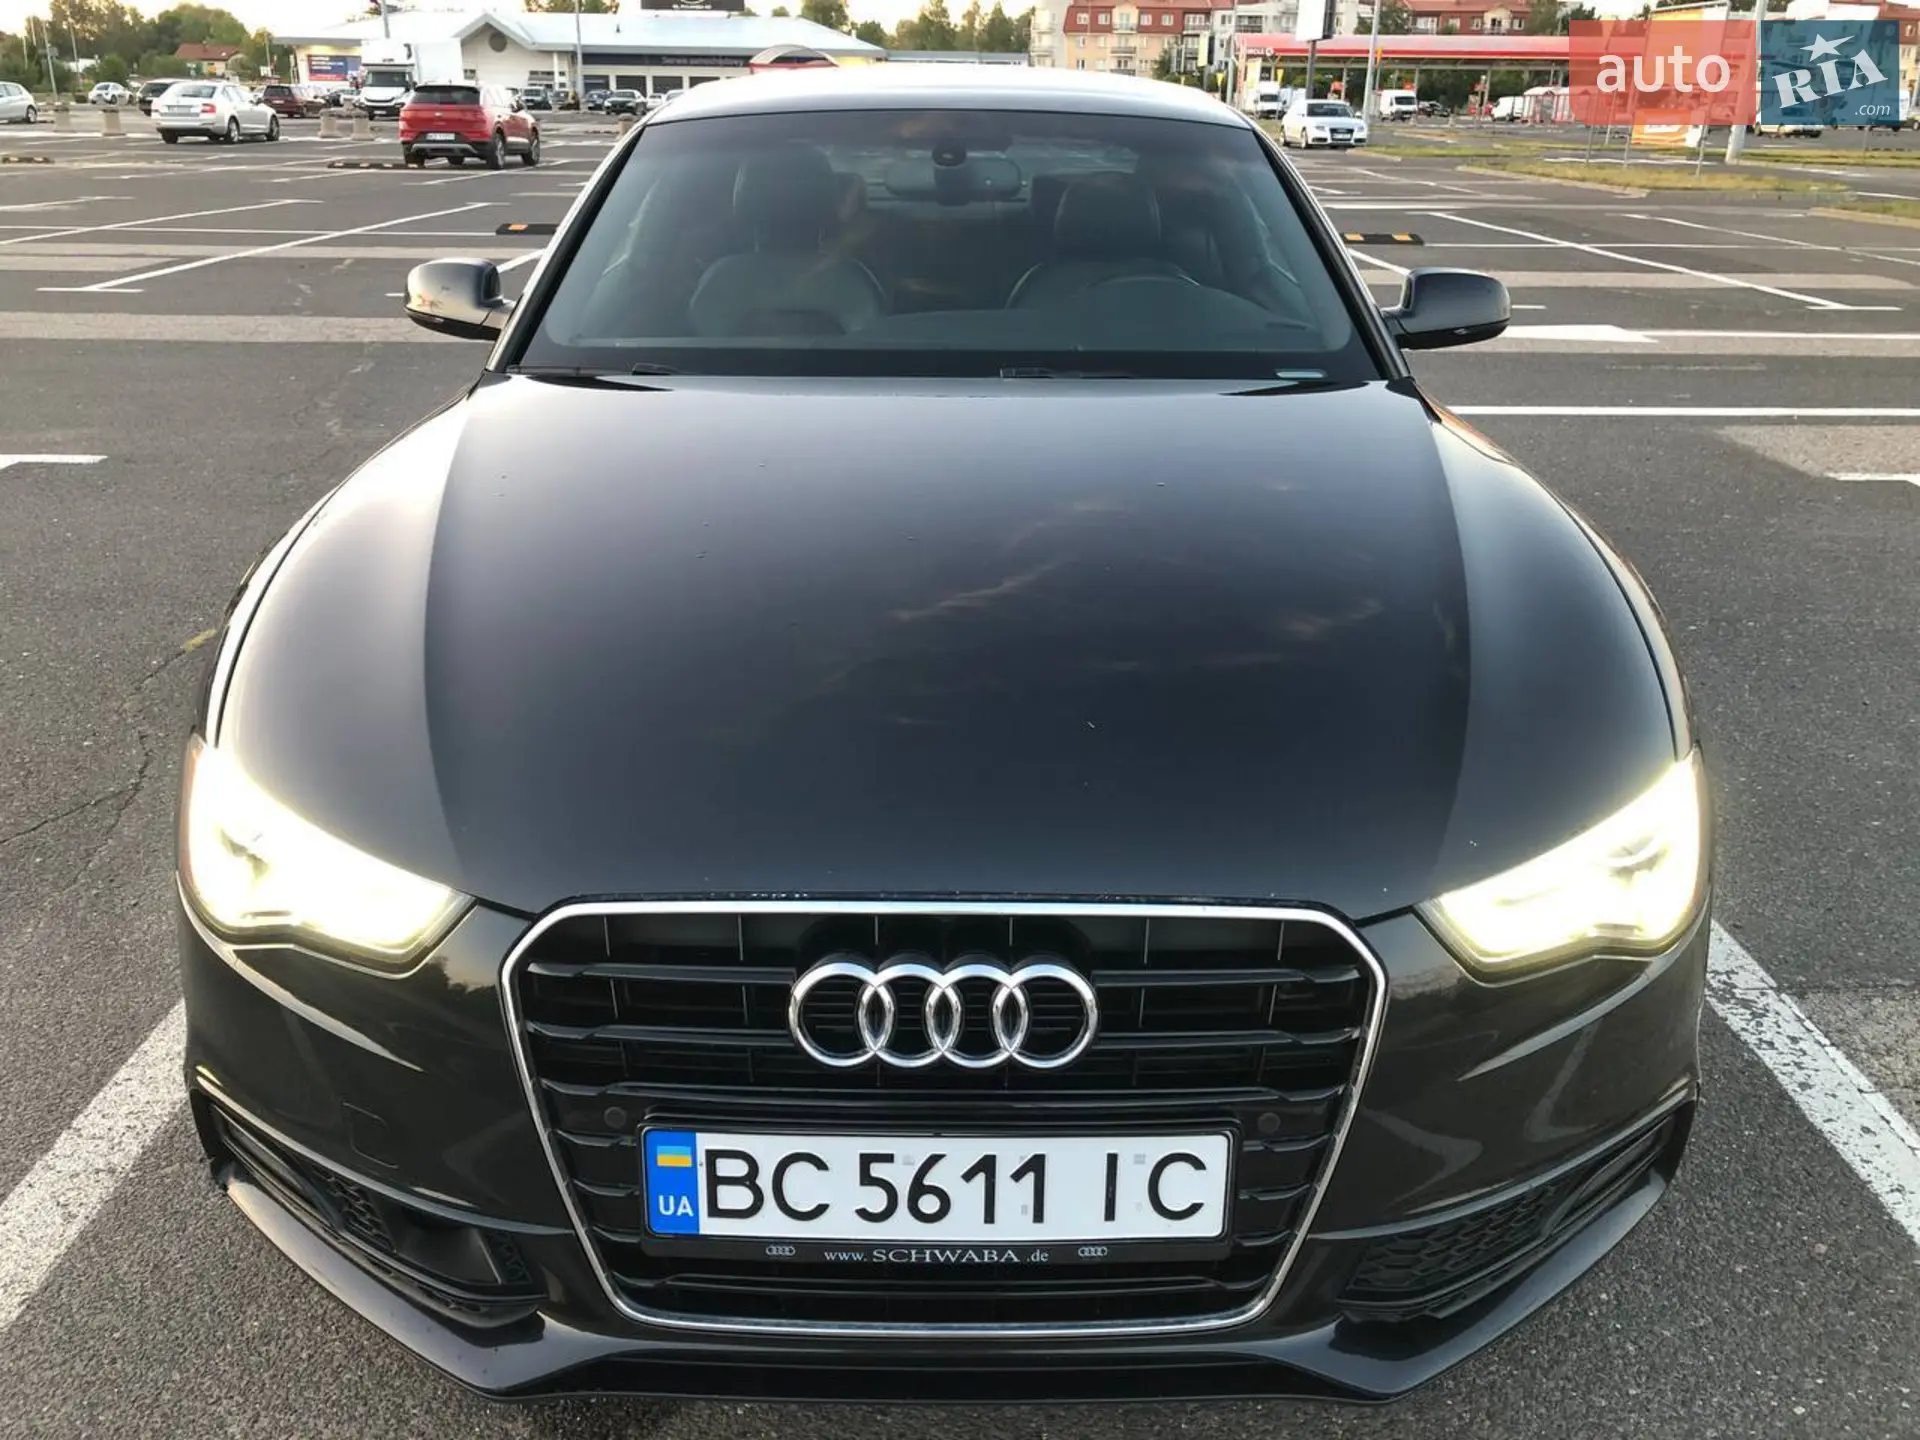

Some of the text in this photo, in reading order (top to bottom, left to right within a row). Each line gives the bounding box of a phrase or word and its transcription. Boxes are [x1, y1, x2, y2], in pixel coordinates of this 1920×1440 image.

[658, 1195, 694, 1218] UA
[704, 1149, 1207, 1225] BC 5611 IC
